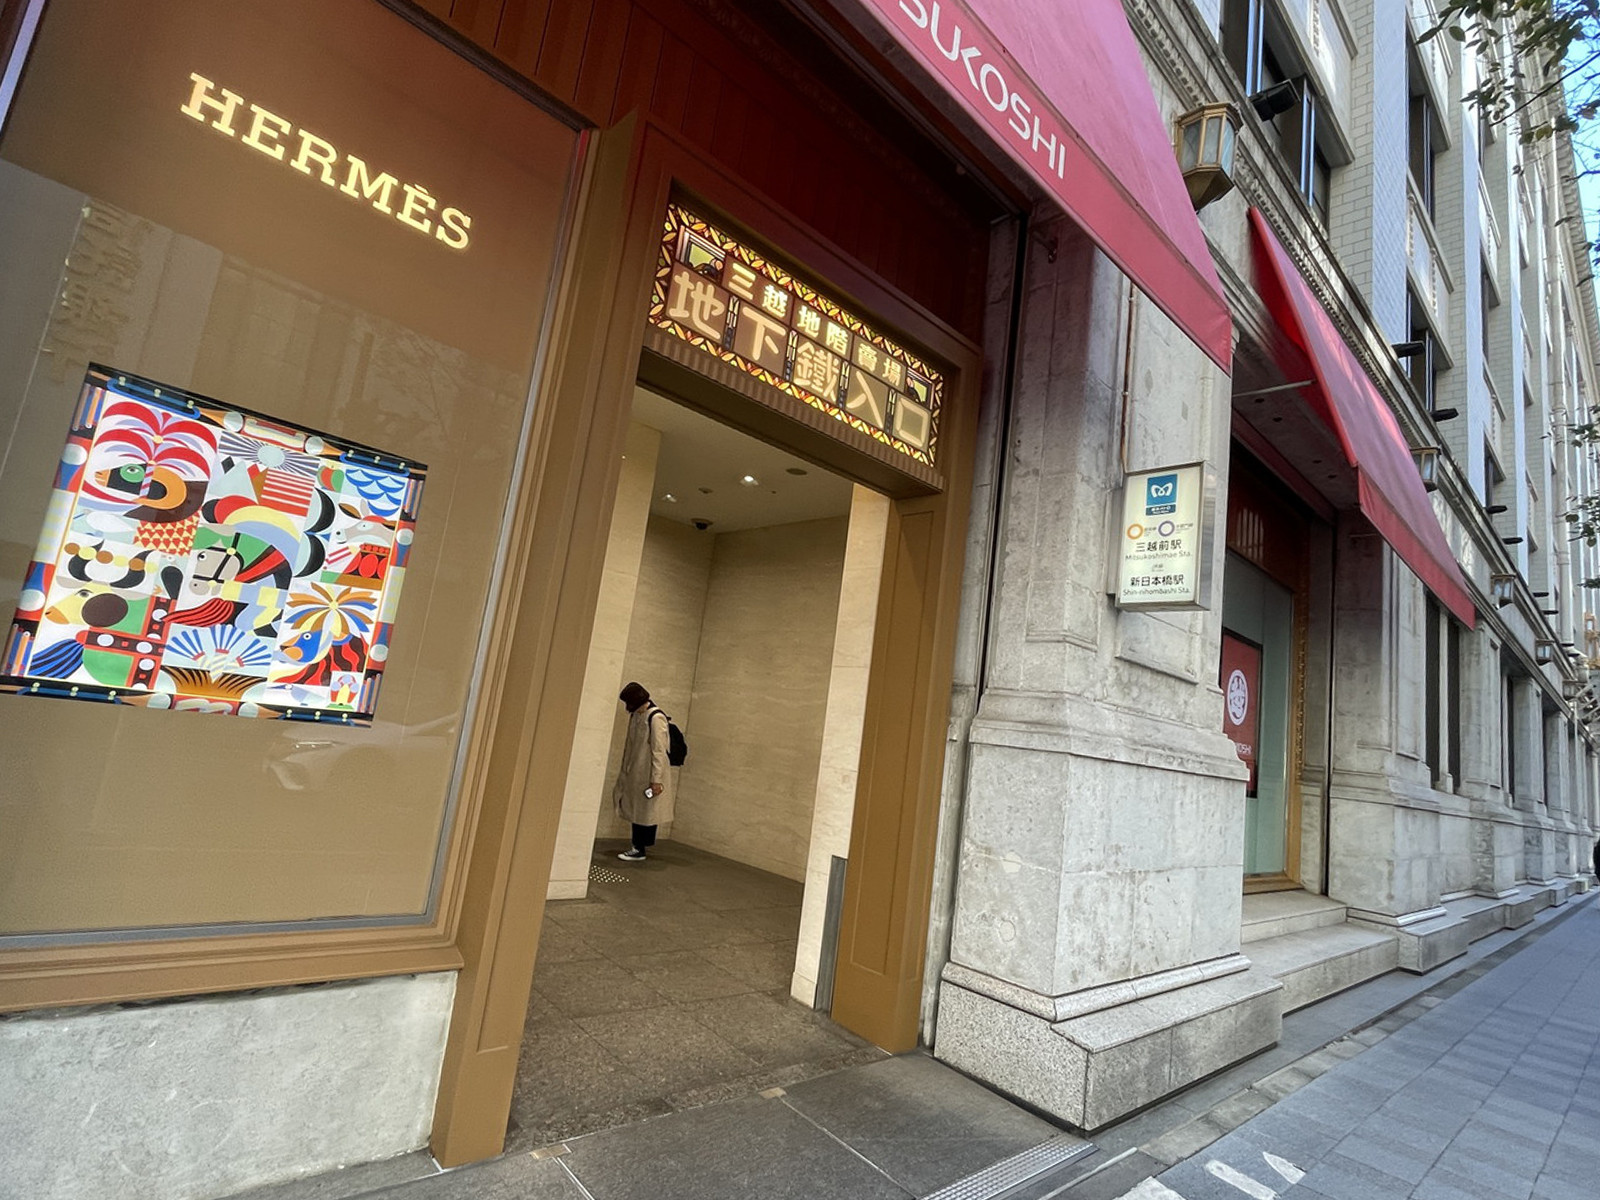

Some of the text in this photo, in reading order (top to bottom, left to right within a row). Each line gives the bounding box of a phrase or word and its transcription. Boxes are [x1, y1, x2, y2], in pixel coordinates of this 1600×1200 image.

[181, 72, 472, 249] HERMÈS
[1135, 539, 1182, 552] 三越前駅
[1125, 551, 1178, 560] Mitsukoshimae
[1130, 574, 1184, 587] 新日本橋駅
